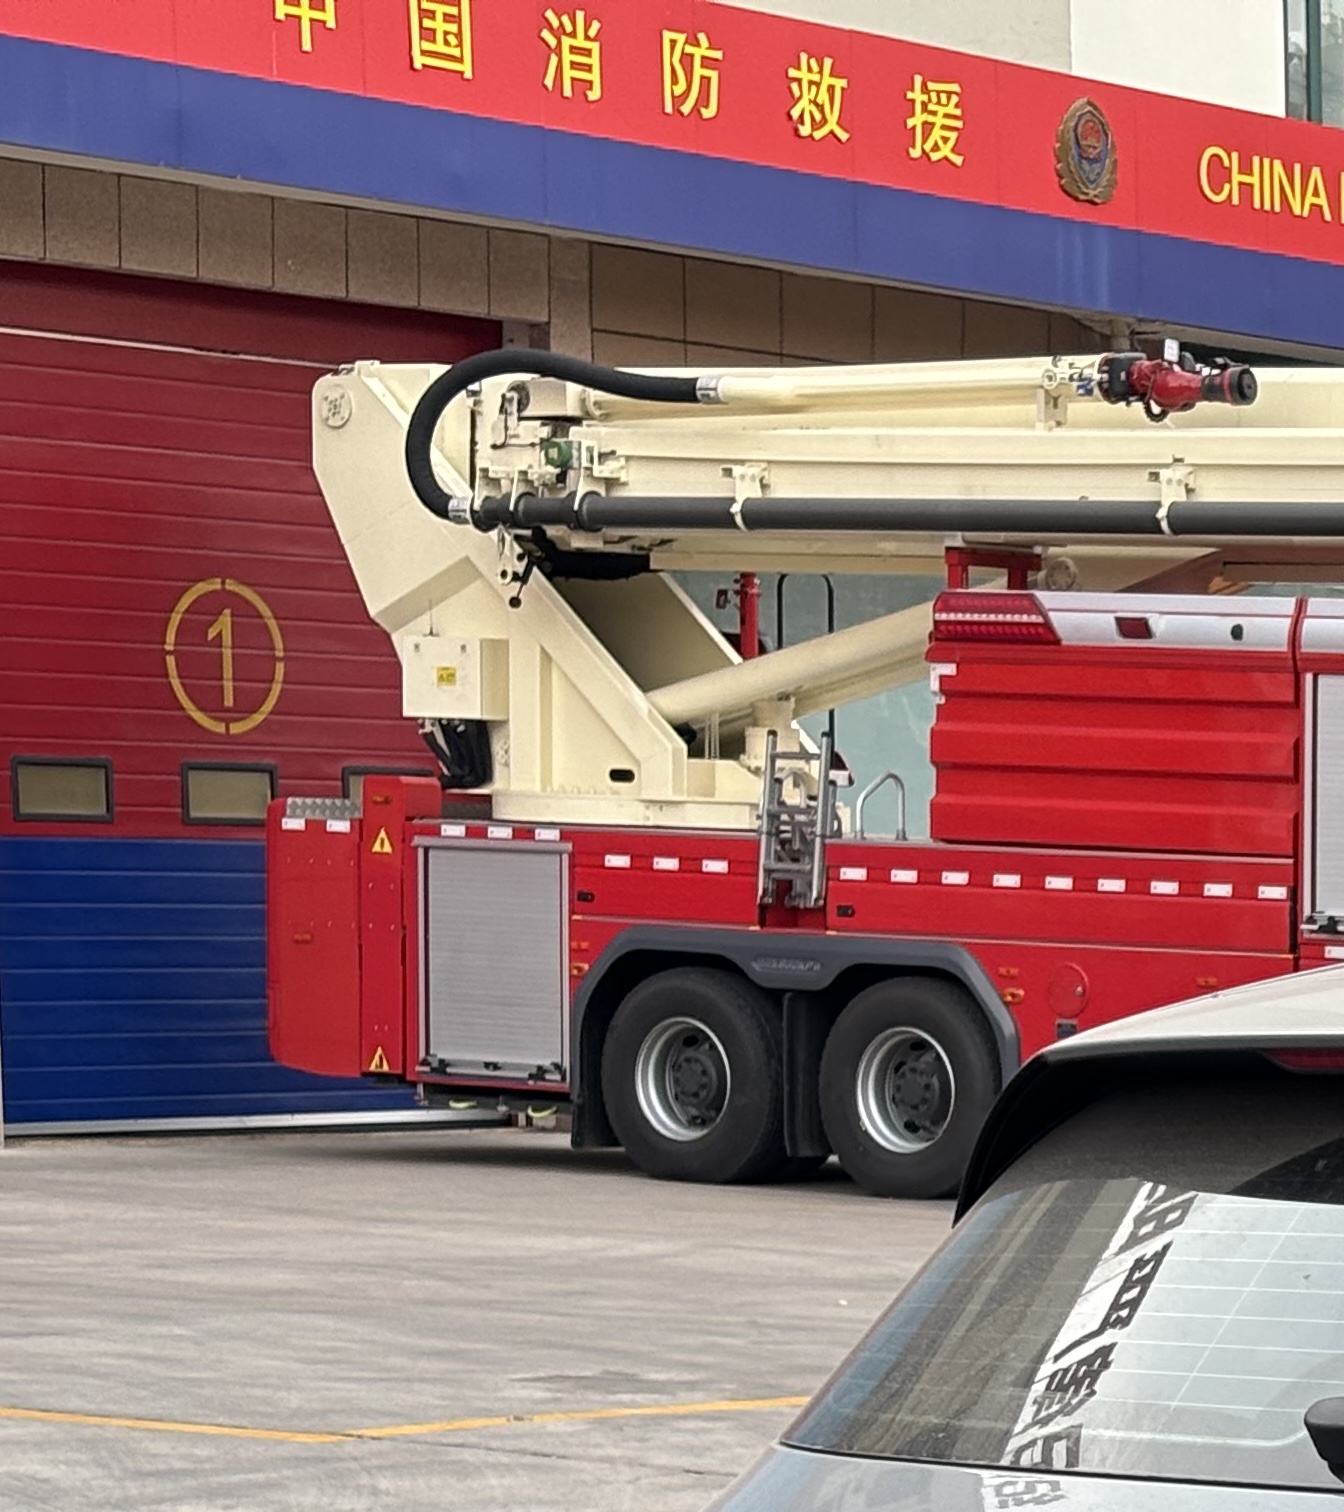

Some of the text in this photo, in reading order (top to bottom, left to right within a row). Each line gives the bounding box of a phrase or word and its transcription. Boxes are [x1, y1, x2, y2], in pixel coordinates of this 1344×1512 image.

[273, 0, 966, 168] 中国消防救援
[1199, 145, 1333, 222] CHINA
